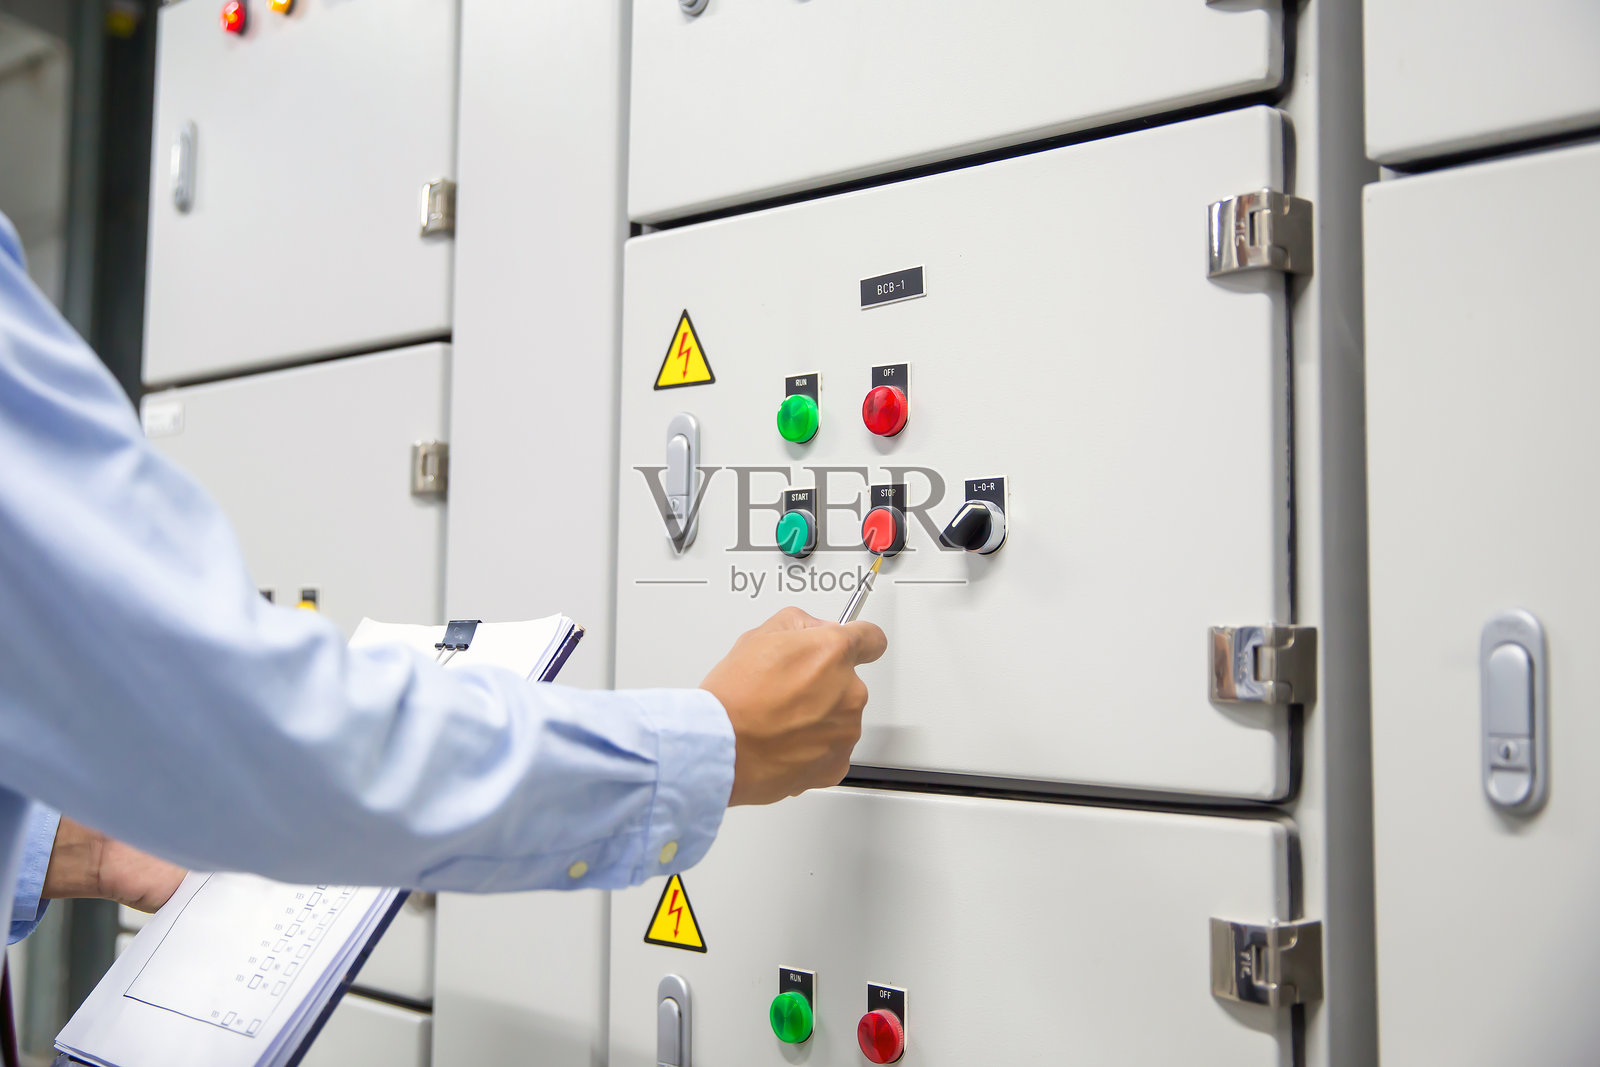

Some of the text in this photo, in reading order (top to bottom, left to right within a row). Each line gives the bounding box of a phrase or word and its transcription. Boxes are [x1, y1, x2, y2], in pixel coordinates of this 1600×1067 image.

[877, 279, 906, 296] BCB-1
[883, 368, 895, 377] OFF
[795, 378, 807, 387] RUN
[791, 493, 809, 502] START
[880, 488, 897, 498] STOP
[790, 973, 802, 983] RUN
[879, 990, 892, 1000] OFF
